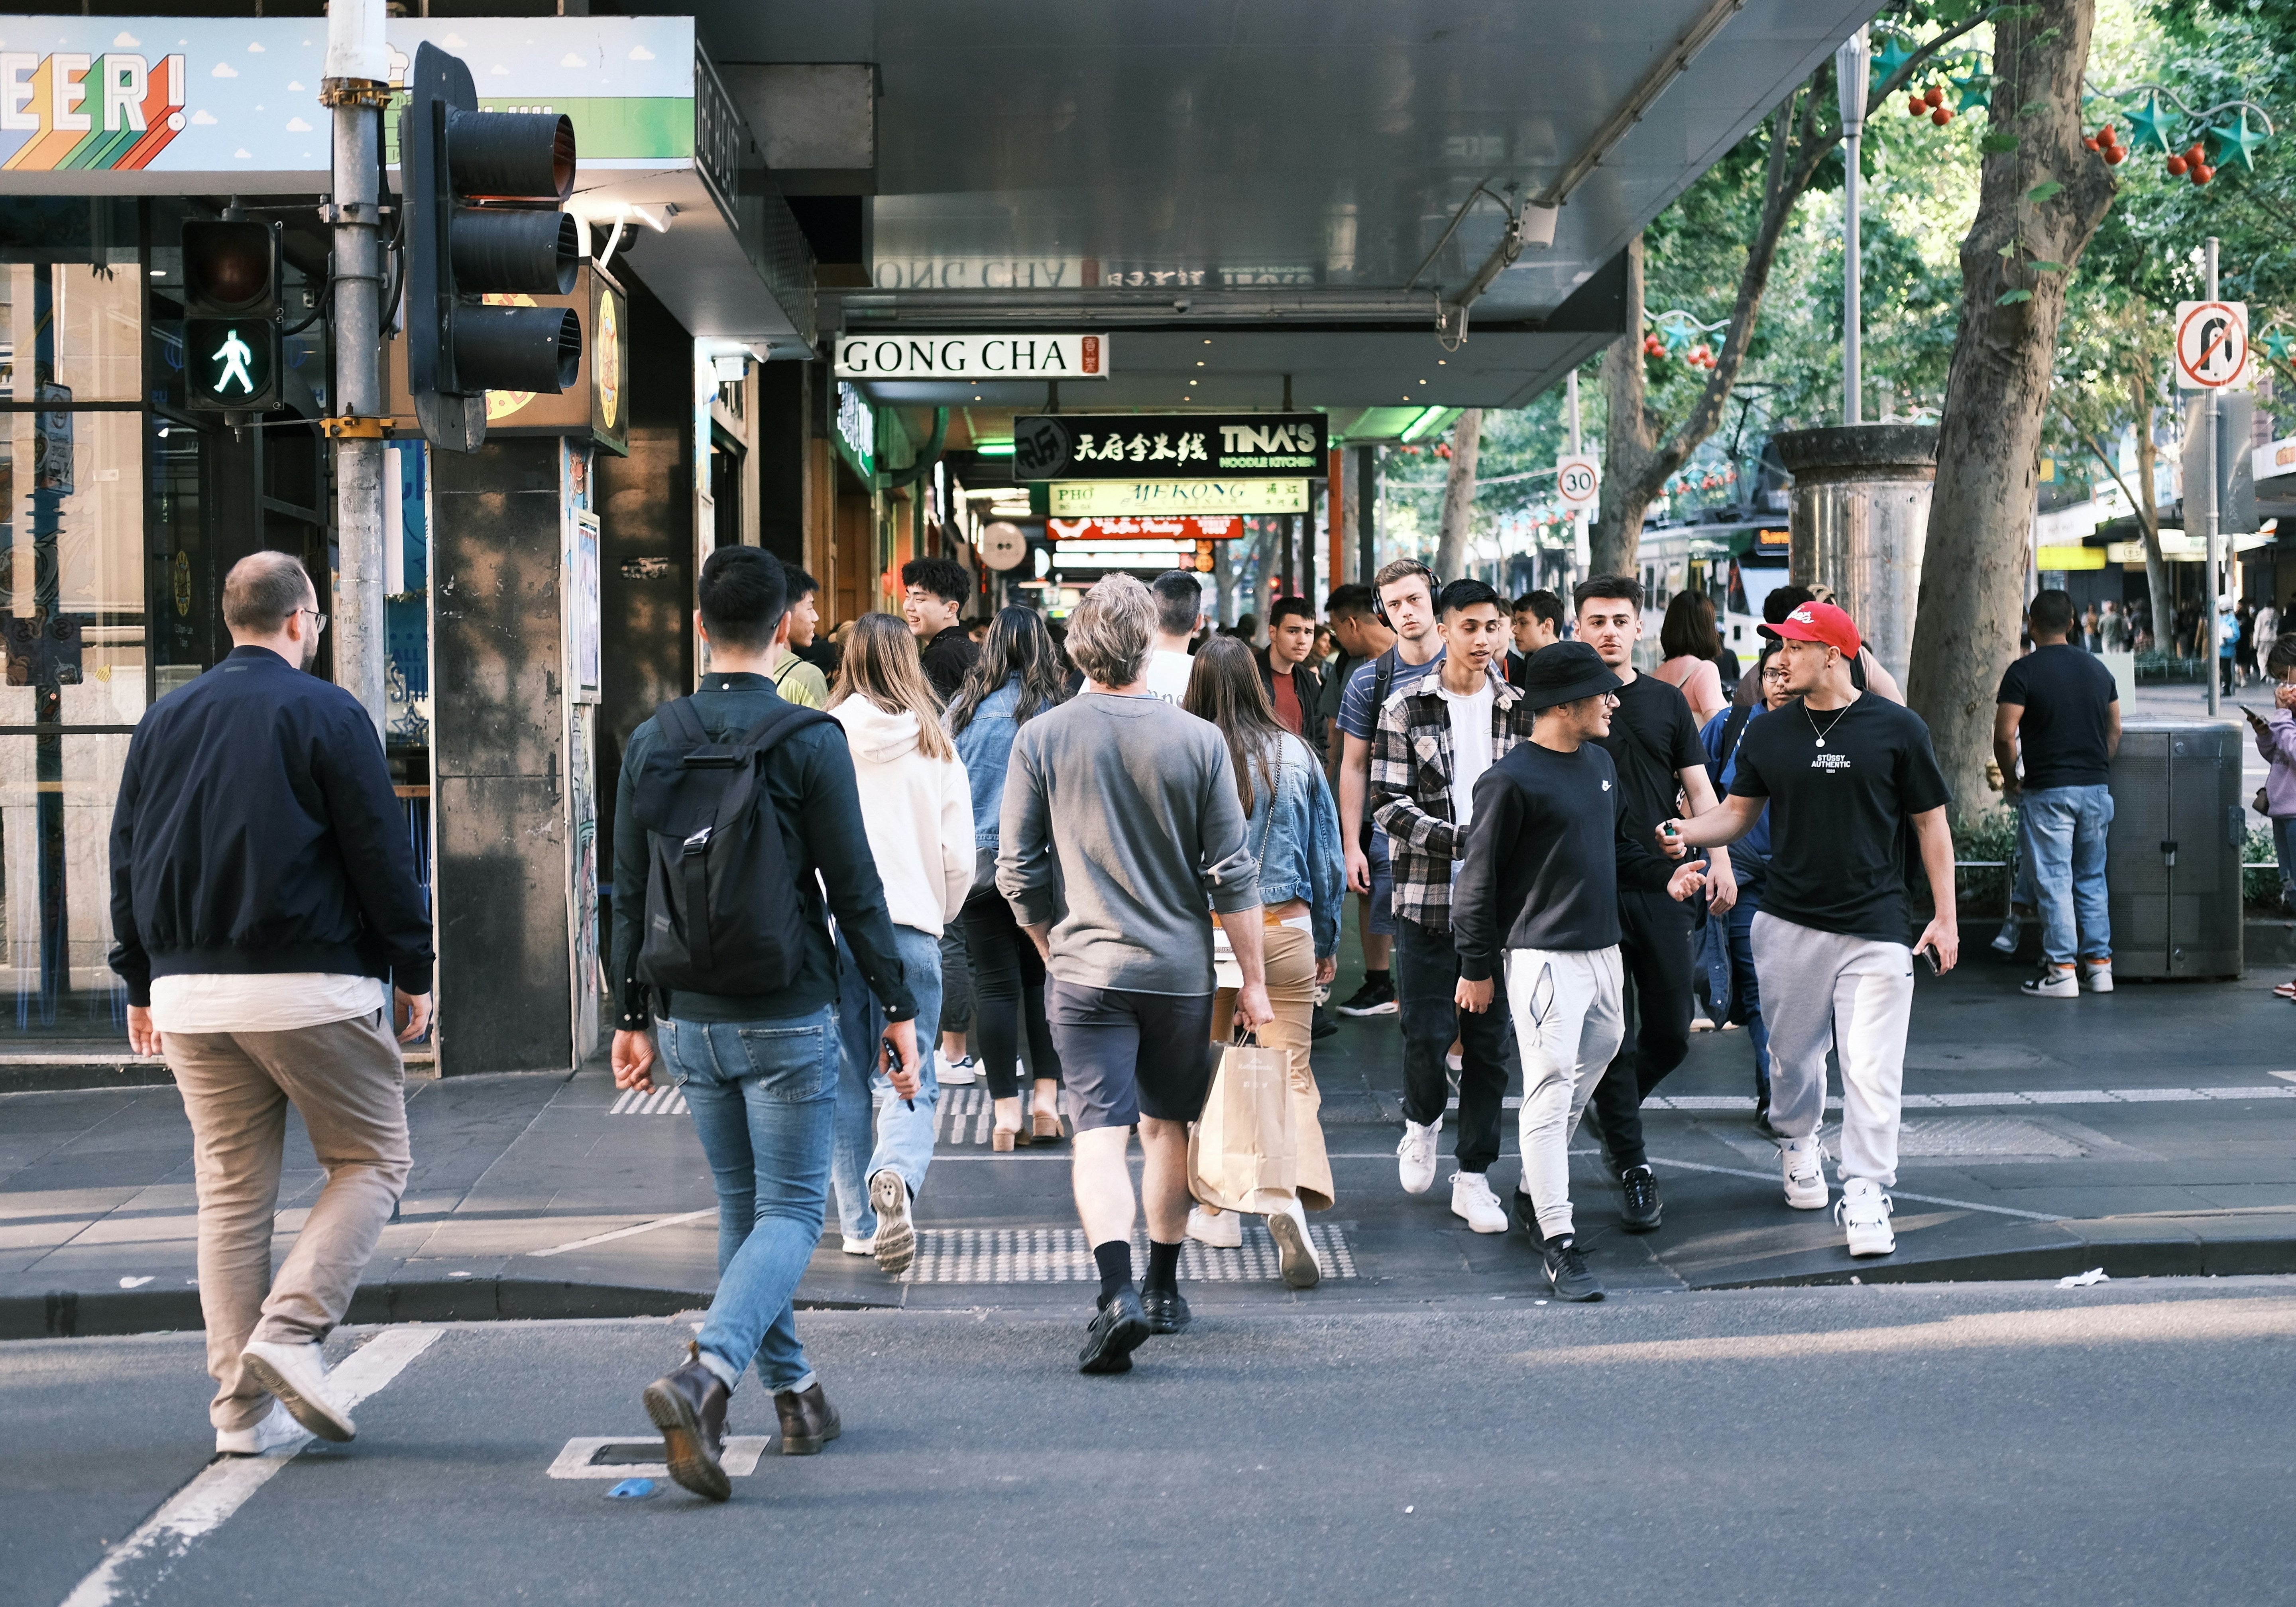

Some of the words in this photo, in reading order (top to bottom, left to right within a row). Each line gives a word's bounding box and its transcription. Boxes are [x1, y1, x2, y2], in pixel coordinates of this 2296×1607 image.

[696, 59, 712, 166] THE
[715, 96, 740, 210] BEAST
[843, 341, 965, 371] GONG
[982, 341, 1067, 370] CHA
[1219, 424, 1317, 454] TINA'S
[1219, 456, 1268, 468] NOODLE
[1268, 456, 1317, 468] KITCHEN
[1120, 483, 1246, 506] MEKONG
[1566, 472, 1591, 491] 30
